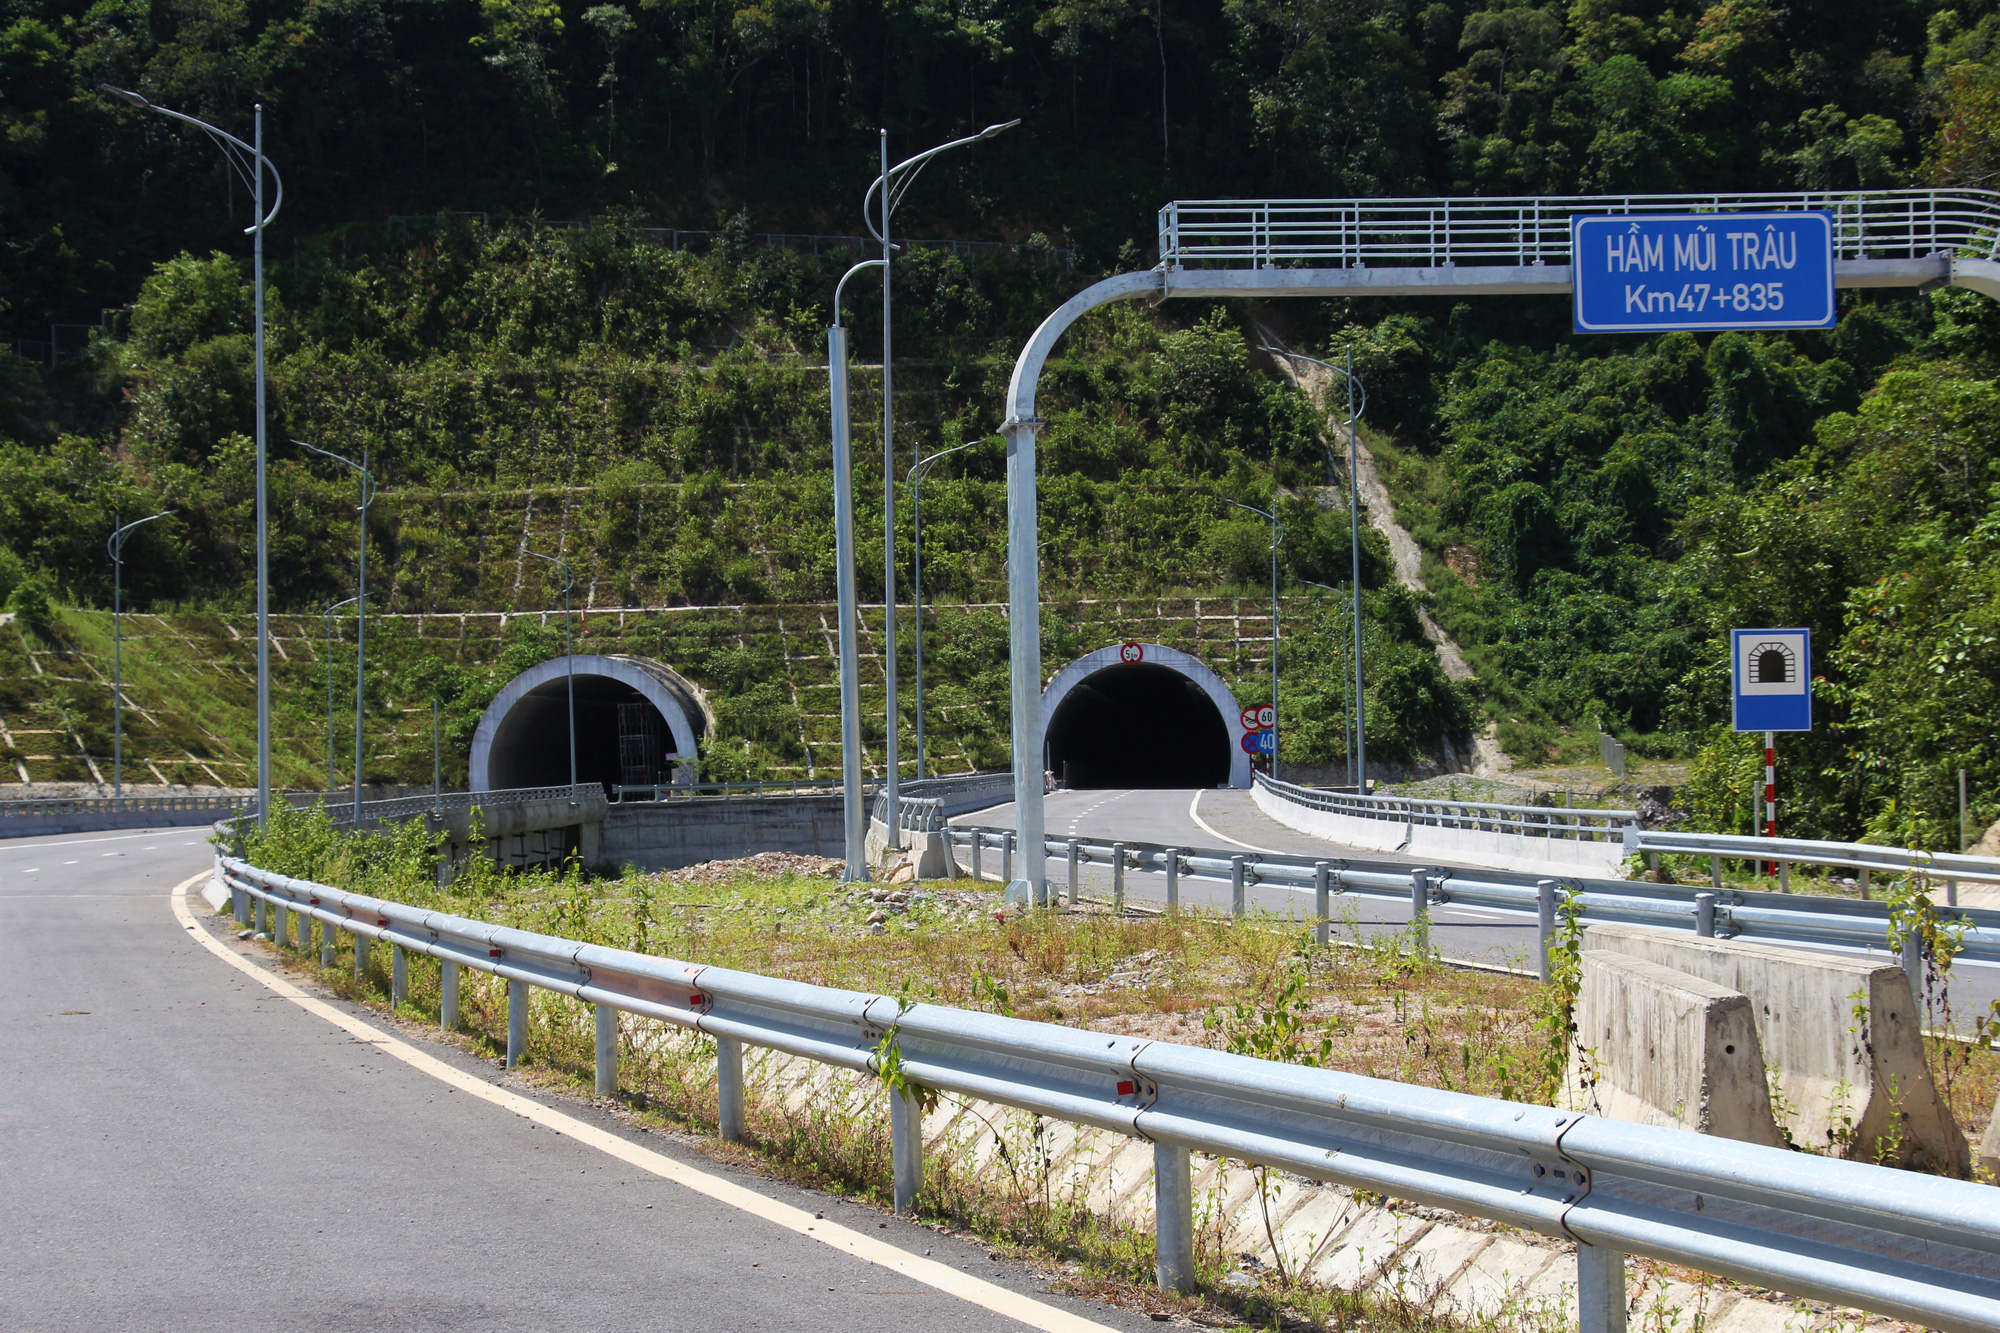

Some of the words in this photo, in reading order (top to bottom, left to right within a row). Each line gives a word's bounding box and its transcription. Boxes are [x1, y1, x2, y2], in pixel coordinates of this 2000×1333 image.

[1607, 222, 1664, 273] HẦM
[1674, 225, 1717, 272] MŨI
[1726, 224, 1797, 271] TRÂU
[1625, 283, 1784, 313] Km47+835
[1262, 711, 1273, 722] 60
[1260, 733, 1275, 750] 40
